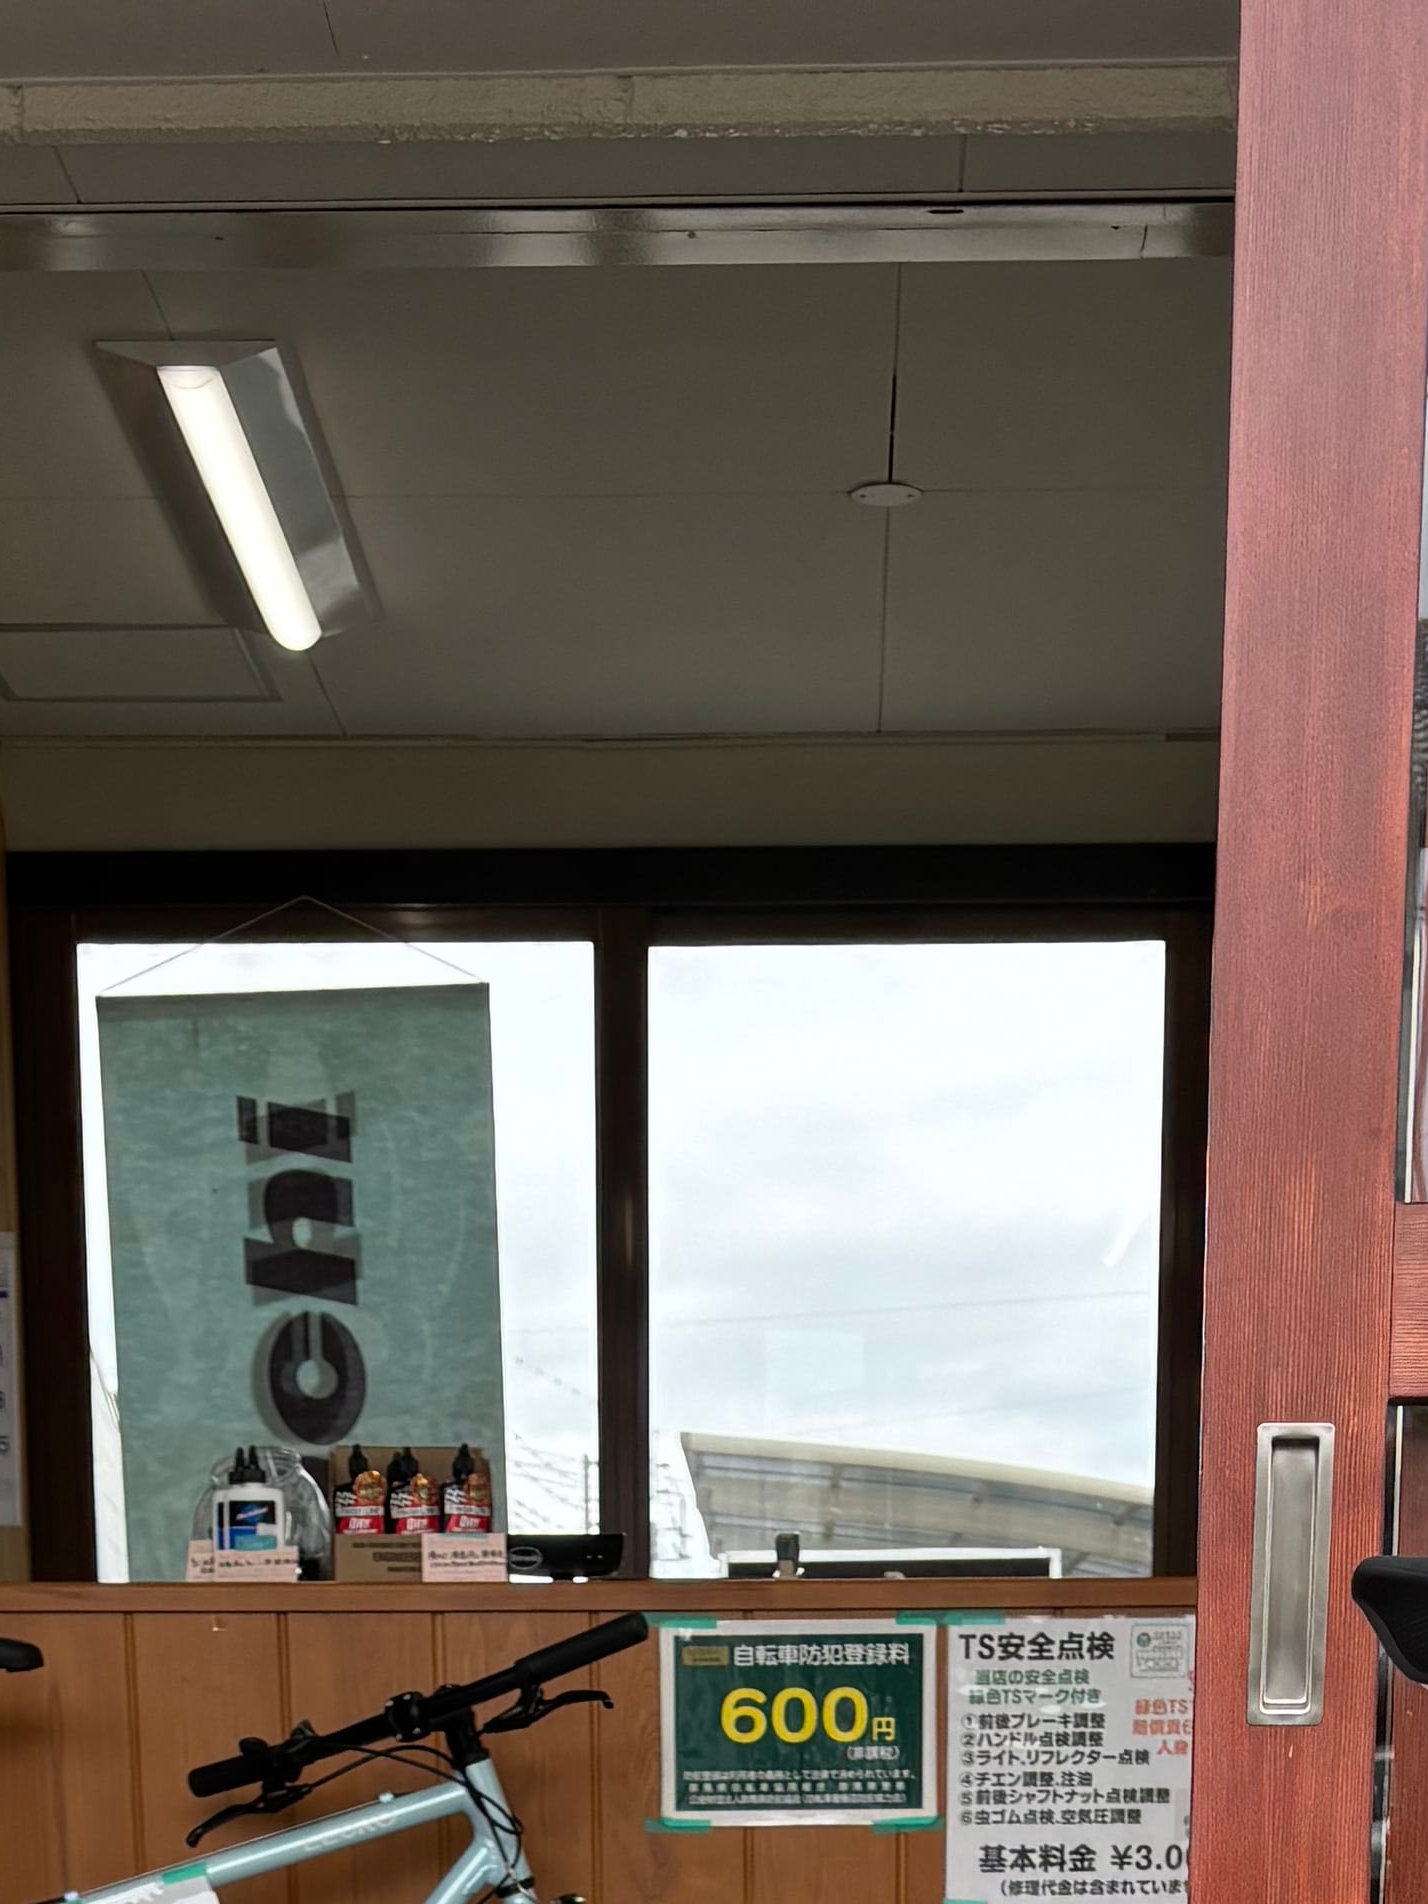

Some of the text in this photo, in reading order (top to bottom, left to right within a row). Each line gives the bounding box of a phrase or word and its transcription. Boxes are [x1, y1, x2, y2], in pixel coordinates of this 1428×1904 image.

[733, 1643, 909, 1666] 自転車防犯登録料
[959, 1632, 1115, 1661] TS安全点検
[975, 1669, 1090, 1686] 当店の安全点検
[969, 1689, 1100, 1705] 緑色TSマーク付き
[721, 1687, 895, 1743] 600円
[979, 1845, 1097, 1873] 基本料金
